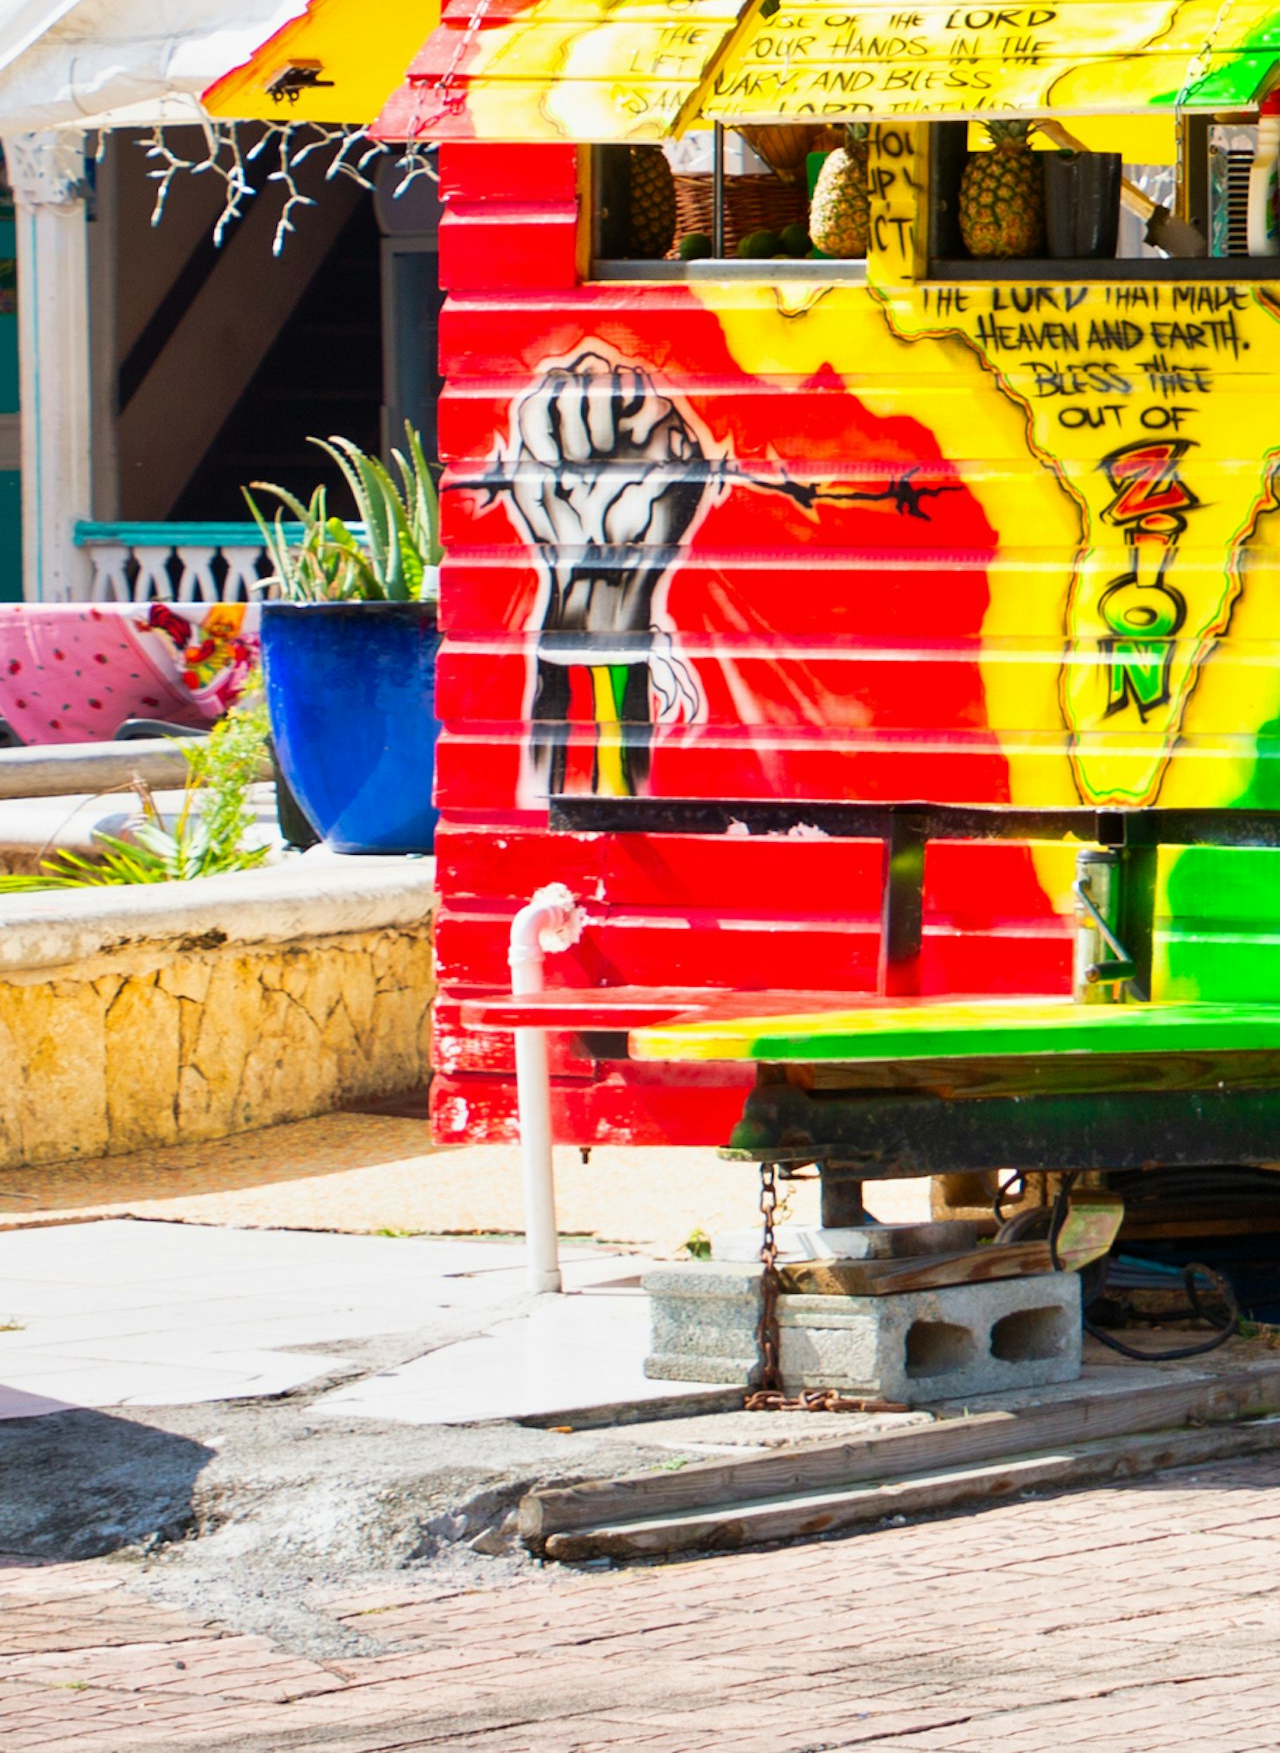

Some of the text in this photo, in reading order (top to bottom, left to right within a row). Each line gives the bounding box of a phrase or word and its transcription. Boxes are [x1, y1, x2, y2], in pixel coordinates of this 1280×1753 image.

[944, 7, 1057, 30] LORD
[830, 25, 929, 58] HANDS
[1000, 35, 1058, 65] THE
[811, 70, 875, 94] AND
[878, 67, 995, 92] BLESS
[975, 309, 1251, 362] HEAVEN AND EARTH.
[1019, 353, 1213, 399] BLESS THEE
[1057, 404, 1200, 432] OUT OF
